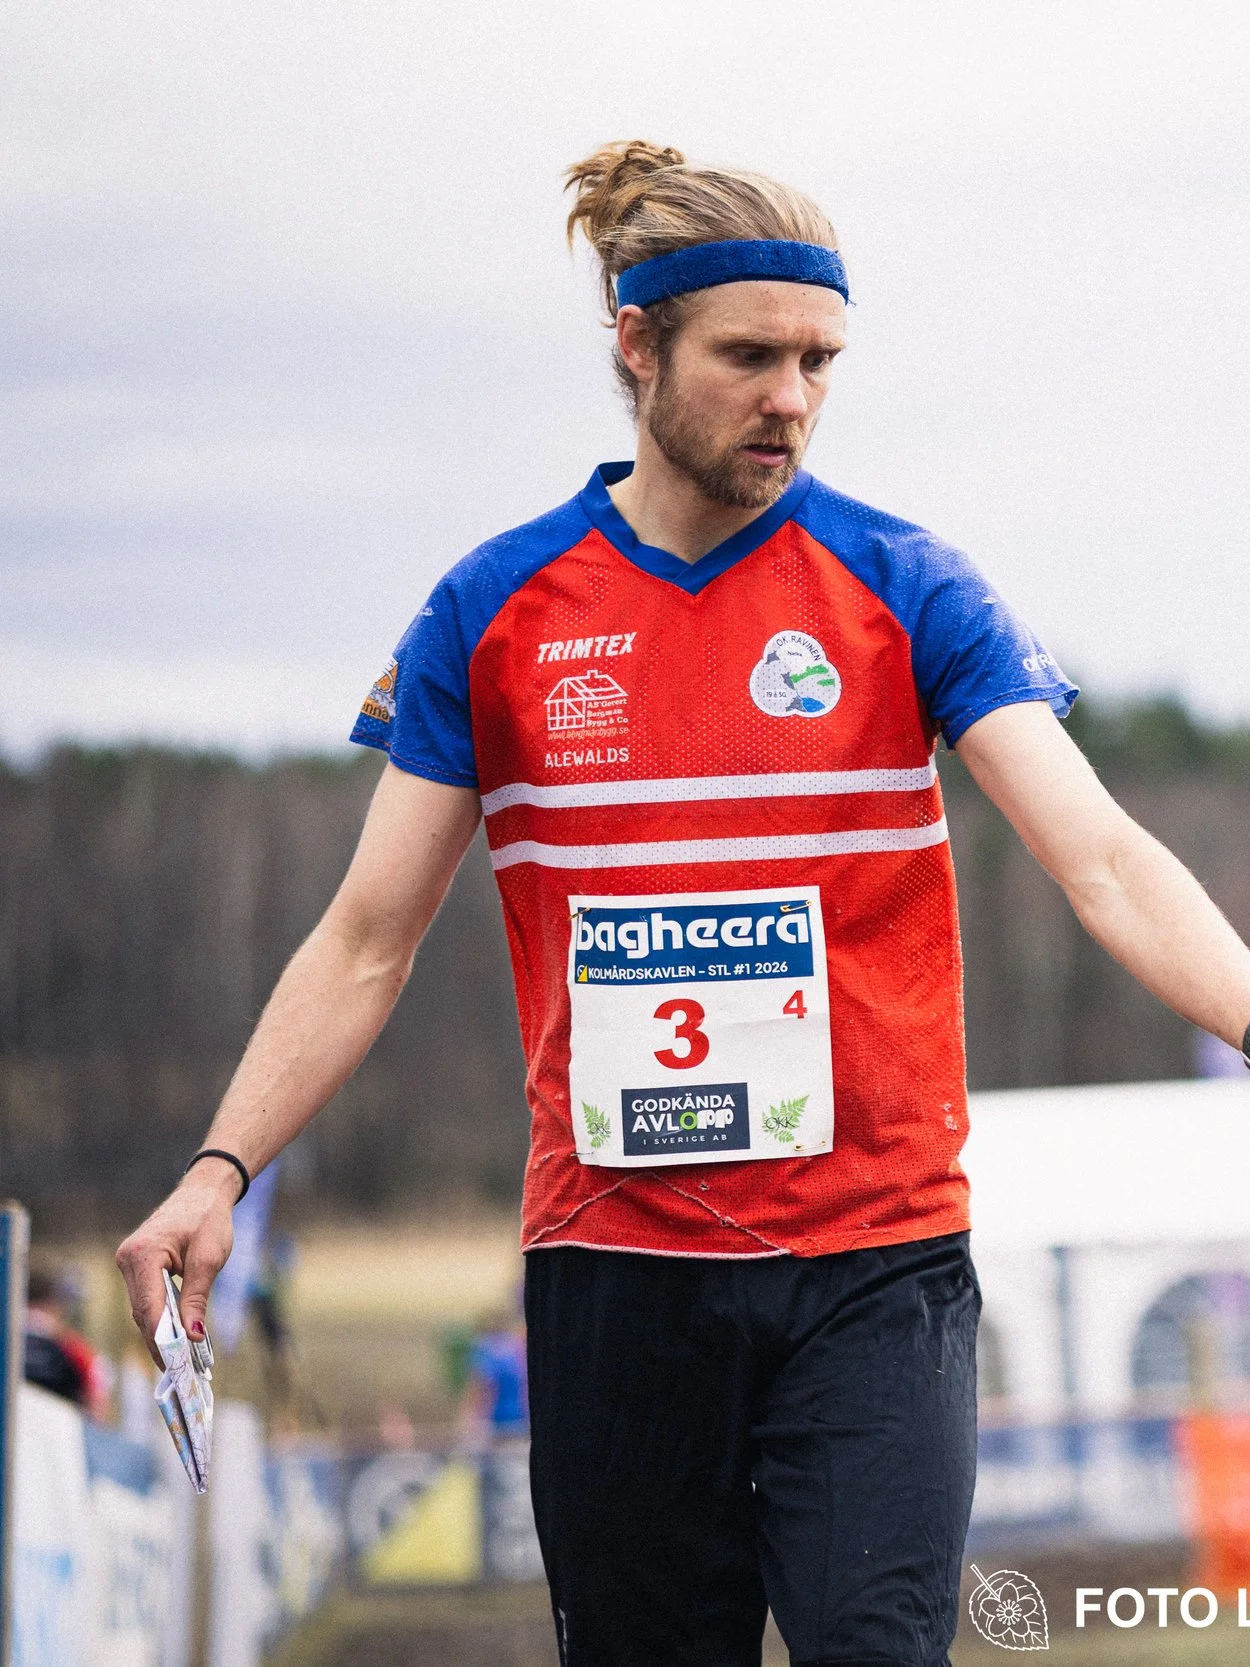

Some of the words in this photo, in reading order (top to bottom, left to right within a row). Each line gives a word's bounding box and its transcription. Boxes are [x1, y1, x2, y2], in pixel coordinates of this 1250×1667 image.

[537, 632, 638, 663] TRIMTEX
[776, 635, 789, 647] OK
[791, 635, 822, 661] RAVINEN
[545, 747, 629, 768] ALEWALDS
[577, 912, 809, 959] bagheera
[589, 965, 696, 980] KOLMÅRDSKAVLEN
[708, 964, 731, 976] STL
[733, 963, 750, 975] #1
[755, 962, 788, 974] 2026
[654, 998, 710, 1069] 3
[782, 990, 808, 1019] 4
[631, 1093, 735, 1113] GODKÄNDA
[654, 1135, 705, 1146] SVERIGE
[713, 1134, 728, 1142] AB
